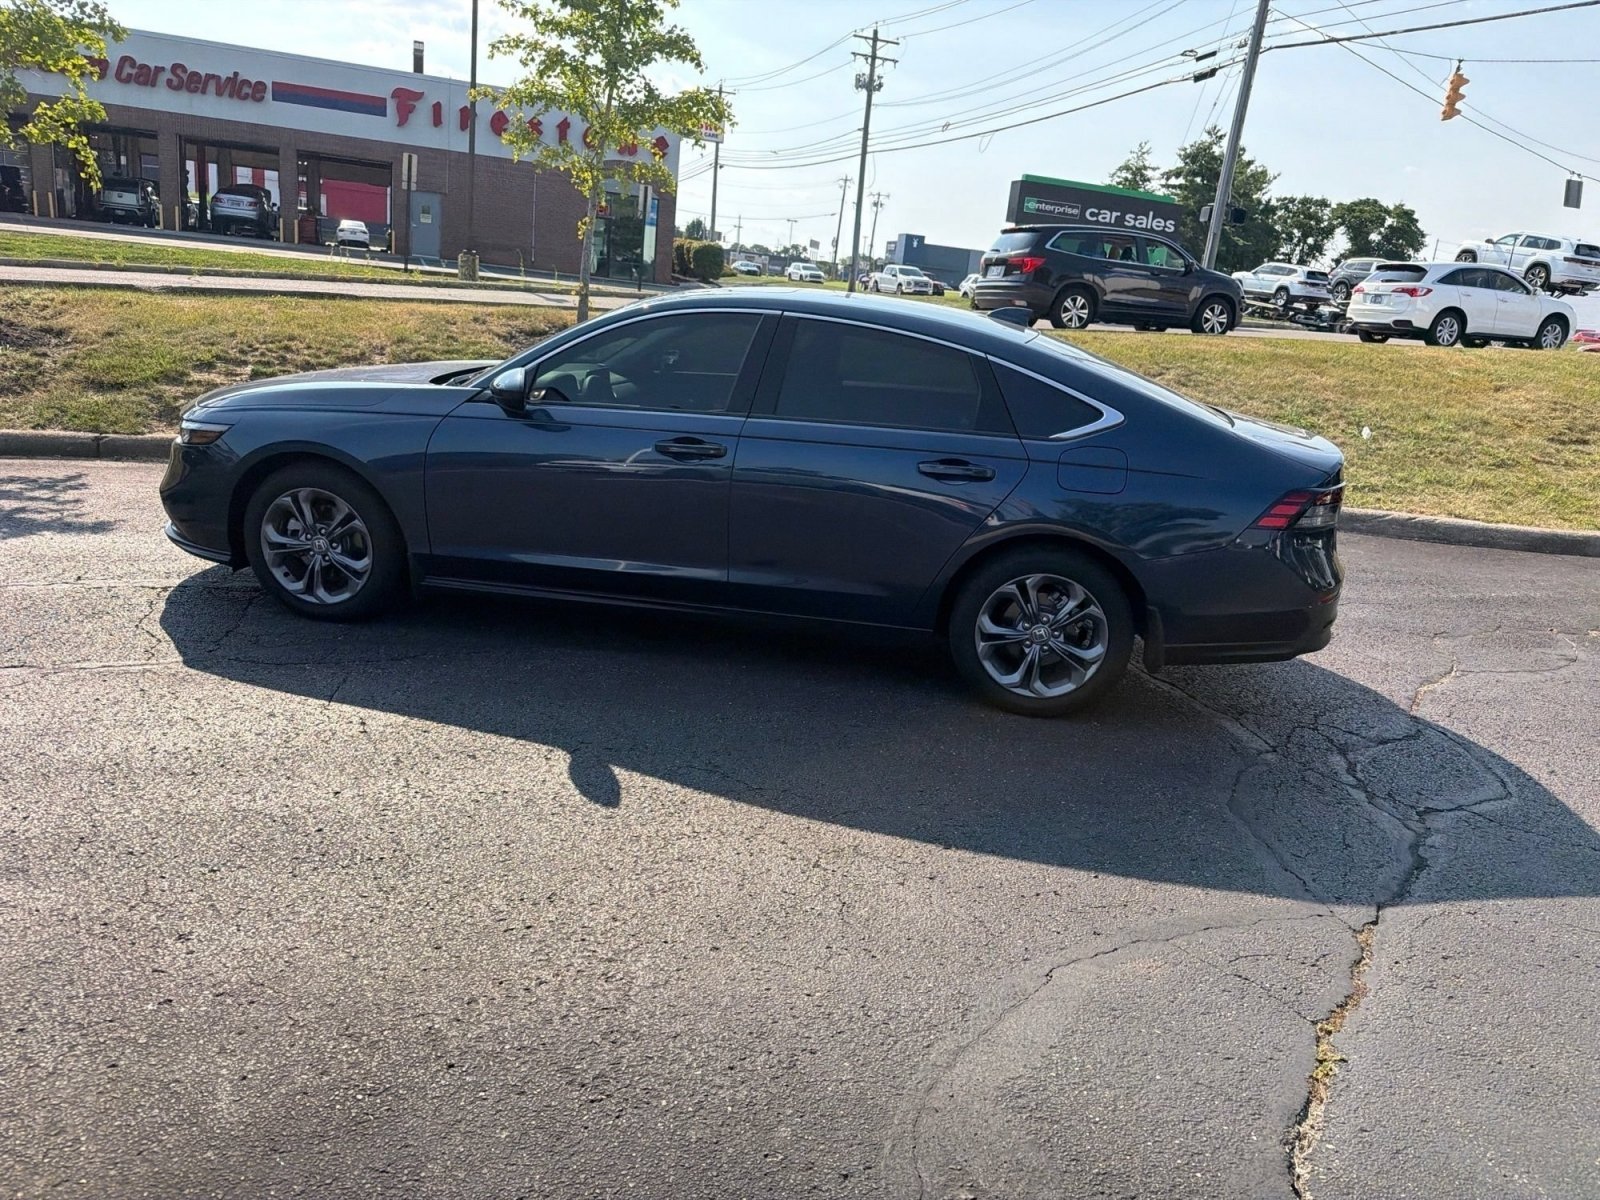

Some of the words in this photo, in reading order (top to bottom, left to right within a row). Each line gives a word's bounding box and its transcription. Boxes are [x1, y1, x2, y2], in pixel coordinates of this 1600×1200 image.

[114, 55, 166, 88] Car
[166, 62, 268, 102] Service
[1027, 200, 1079, 216] enterprise
[1085, 207, 1120, 224] car
[1124, 210, 1176, 233] sales
